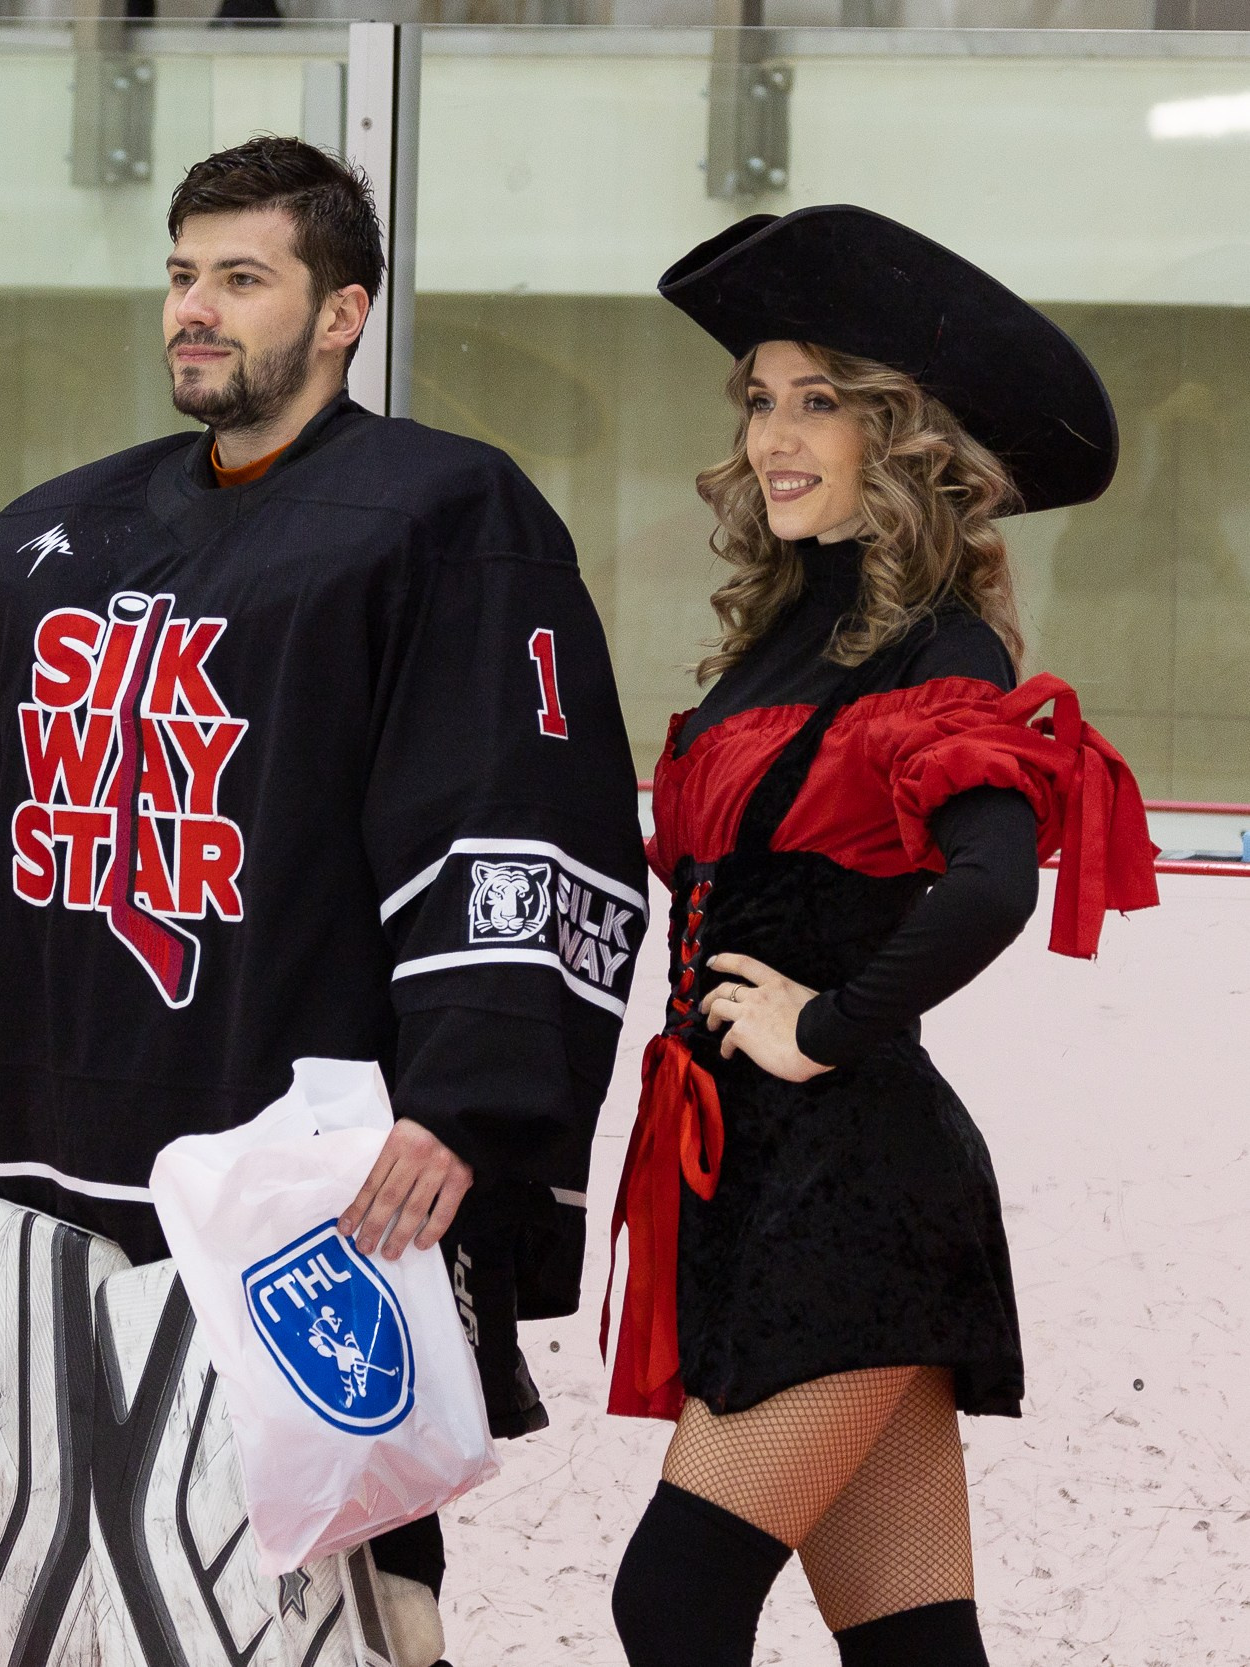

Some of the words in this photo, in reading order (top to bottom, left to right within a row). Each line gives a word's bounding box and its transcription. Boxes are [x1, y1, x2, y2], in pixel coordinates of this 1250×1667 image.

[528, 627, 568, 740] 1
[18, 702, 249, 818] WAY
[11, 799, 245, 922] STAR
[556, 872, 634, 954] SILK
[557, 919, 630, 989] WAY
